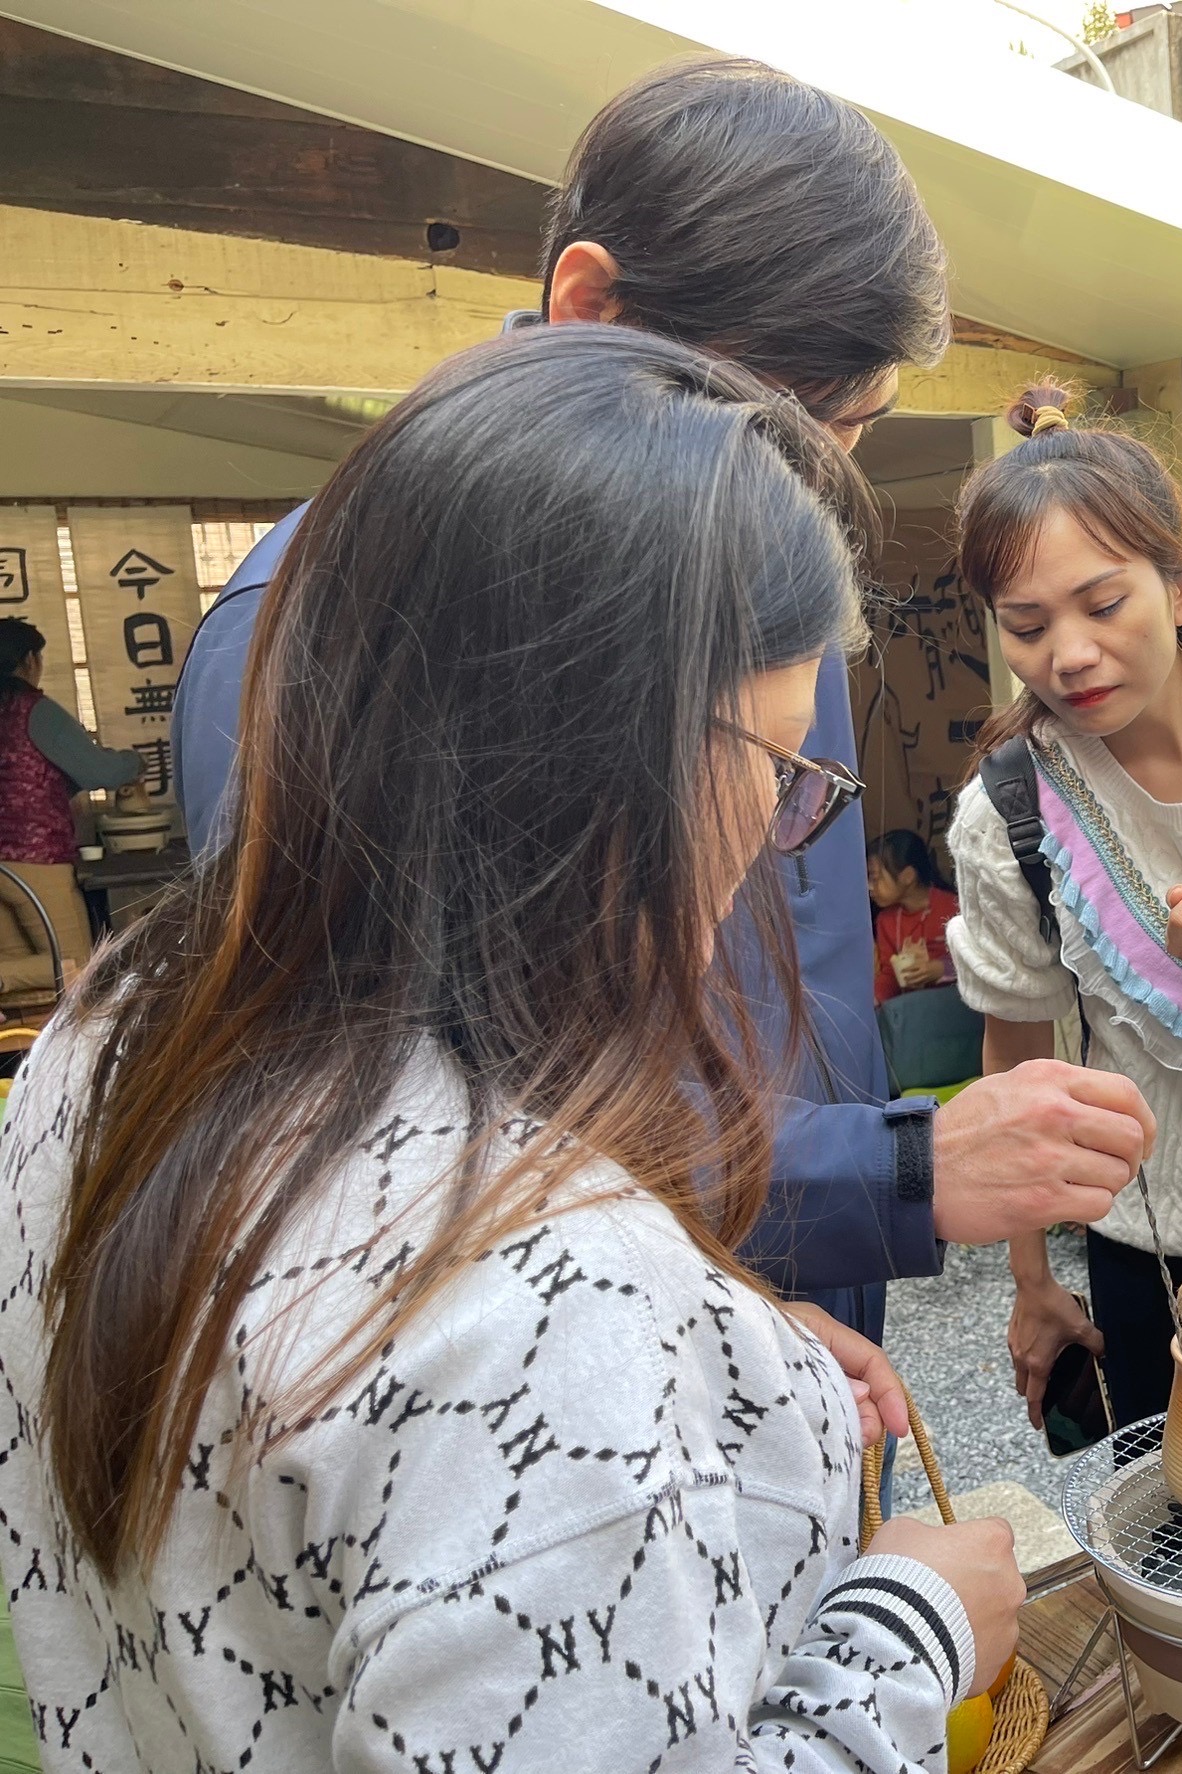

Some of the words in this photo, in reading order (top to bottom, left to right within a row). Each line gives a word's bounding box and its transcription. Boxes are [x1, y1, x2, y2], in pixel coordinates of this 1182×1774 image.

[346, 1366, 434, 1434] NY
[536, 1605, 616, 1682] NY
[664, 1666, 719, 1749] NY
